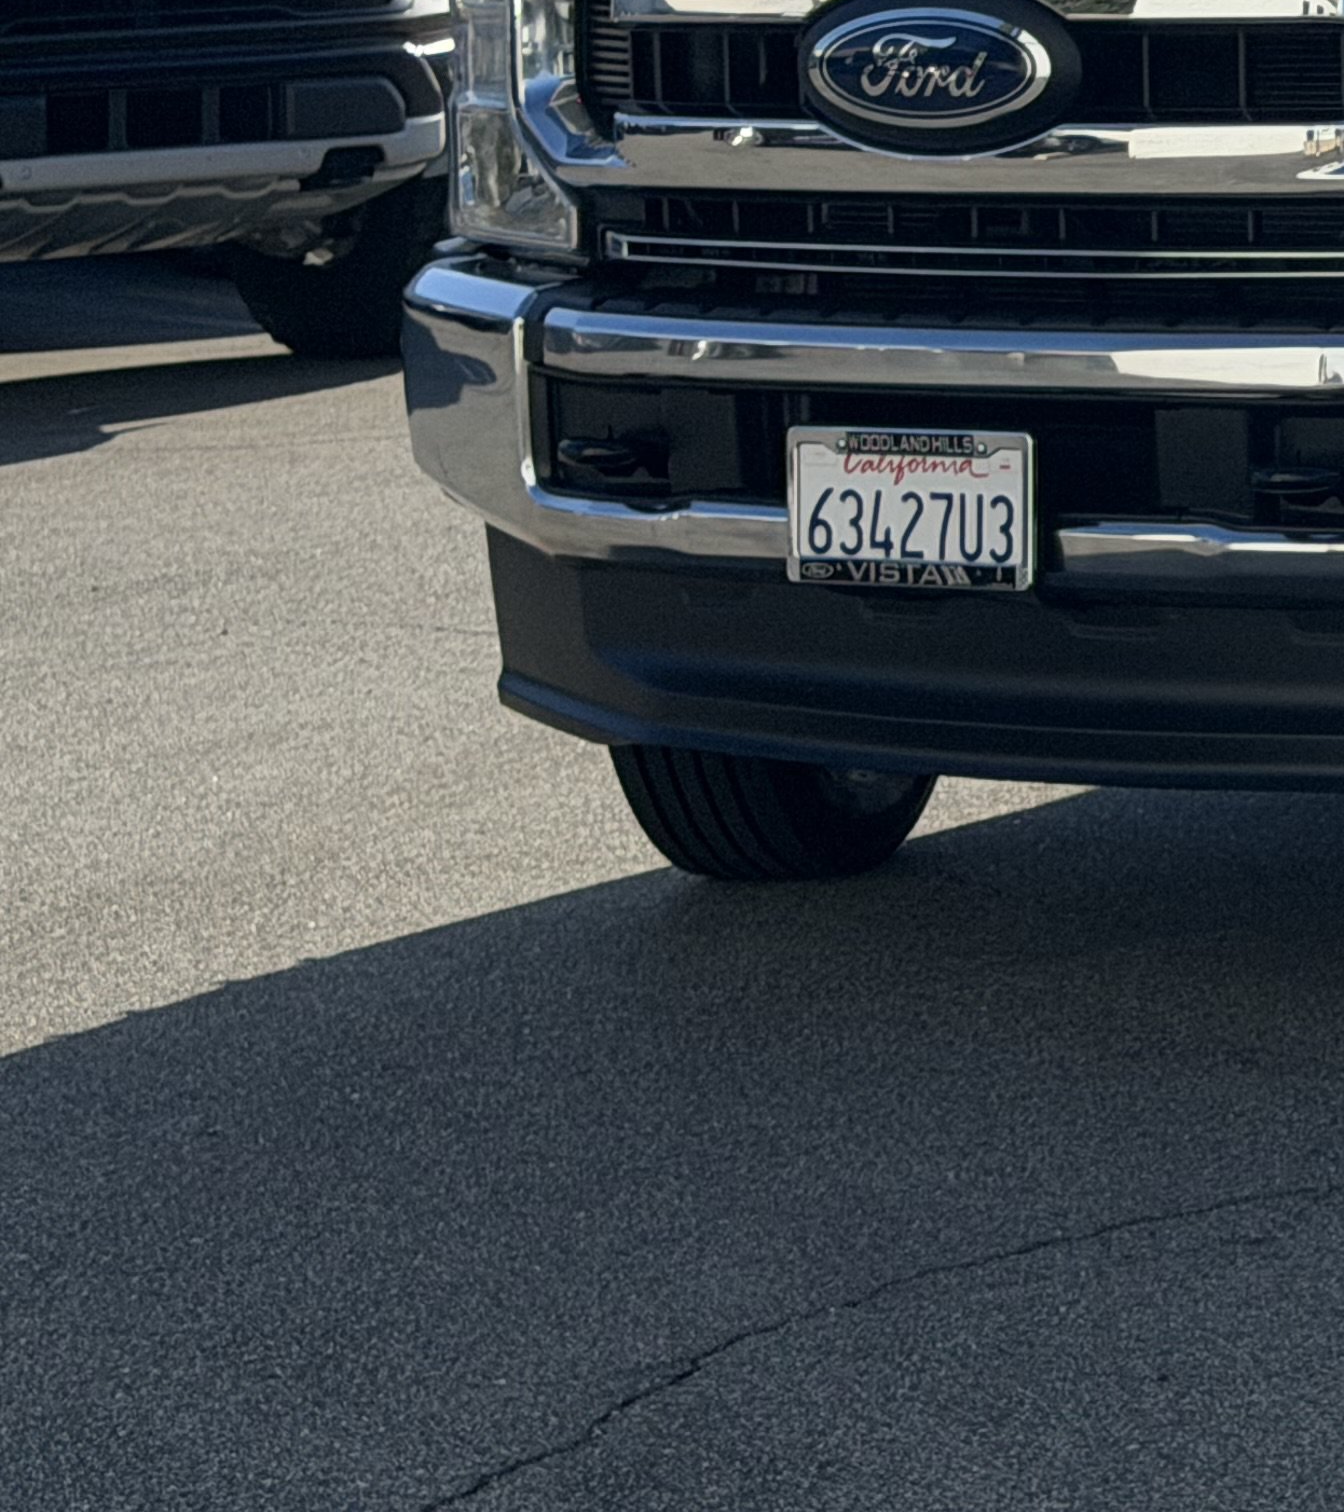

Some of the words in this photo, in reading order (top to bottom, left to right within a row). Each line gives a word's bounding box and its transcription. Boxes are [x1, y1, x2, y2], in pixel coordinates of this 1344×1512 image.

[860, 32, 988, 98] Ford
[848, 433, 931, 452] WOODLAND
[932, 437, 974, 453] HILLS
[843, 452, 990, 486] California
[808, 487, 1015, 564] 63427U3
[846, 560, 944, 586] VISTA
